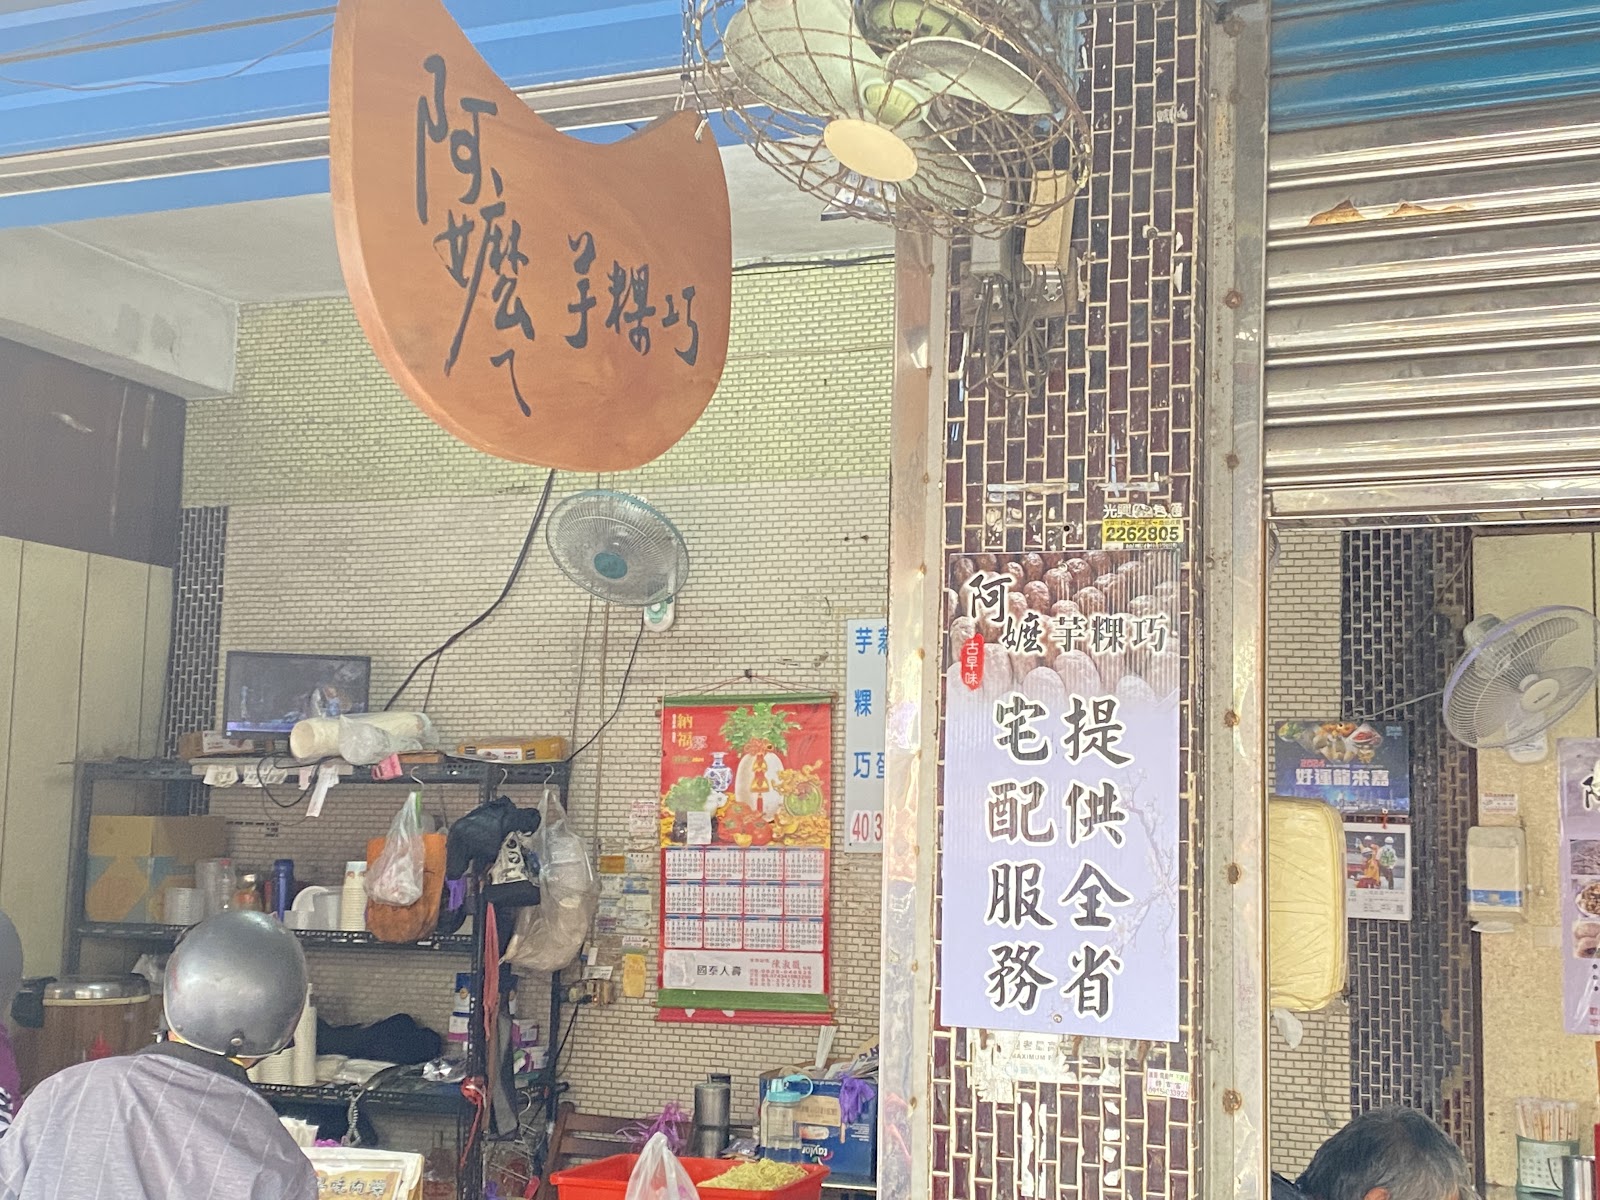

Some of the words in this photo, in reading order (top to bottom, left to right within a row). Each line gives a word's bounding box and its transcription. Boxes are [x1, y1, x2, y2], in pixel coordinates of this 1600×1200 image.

[1106, 526, 1179, 542] 2262805
[964, 640, 980, 686] 古早味
[853, 627, 873, 779] 芋粿巧
[1295, 768, 1390, 787] 好運龍來嘉
[852, 812, 870, 842] 40
[987, 696, 1056, 1012] 宅配服務
[1062, 696, 1133, 1018] 提供全省
[696, 964, 742, 977] 國泰人壽
